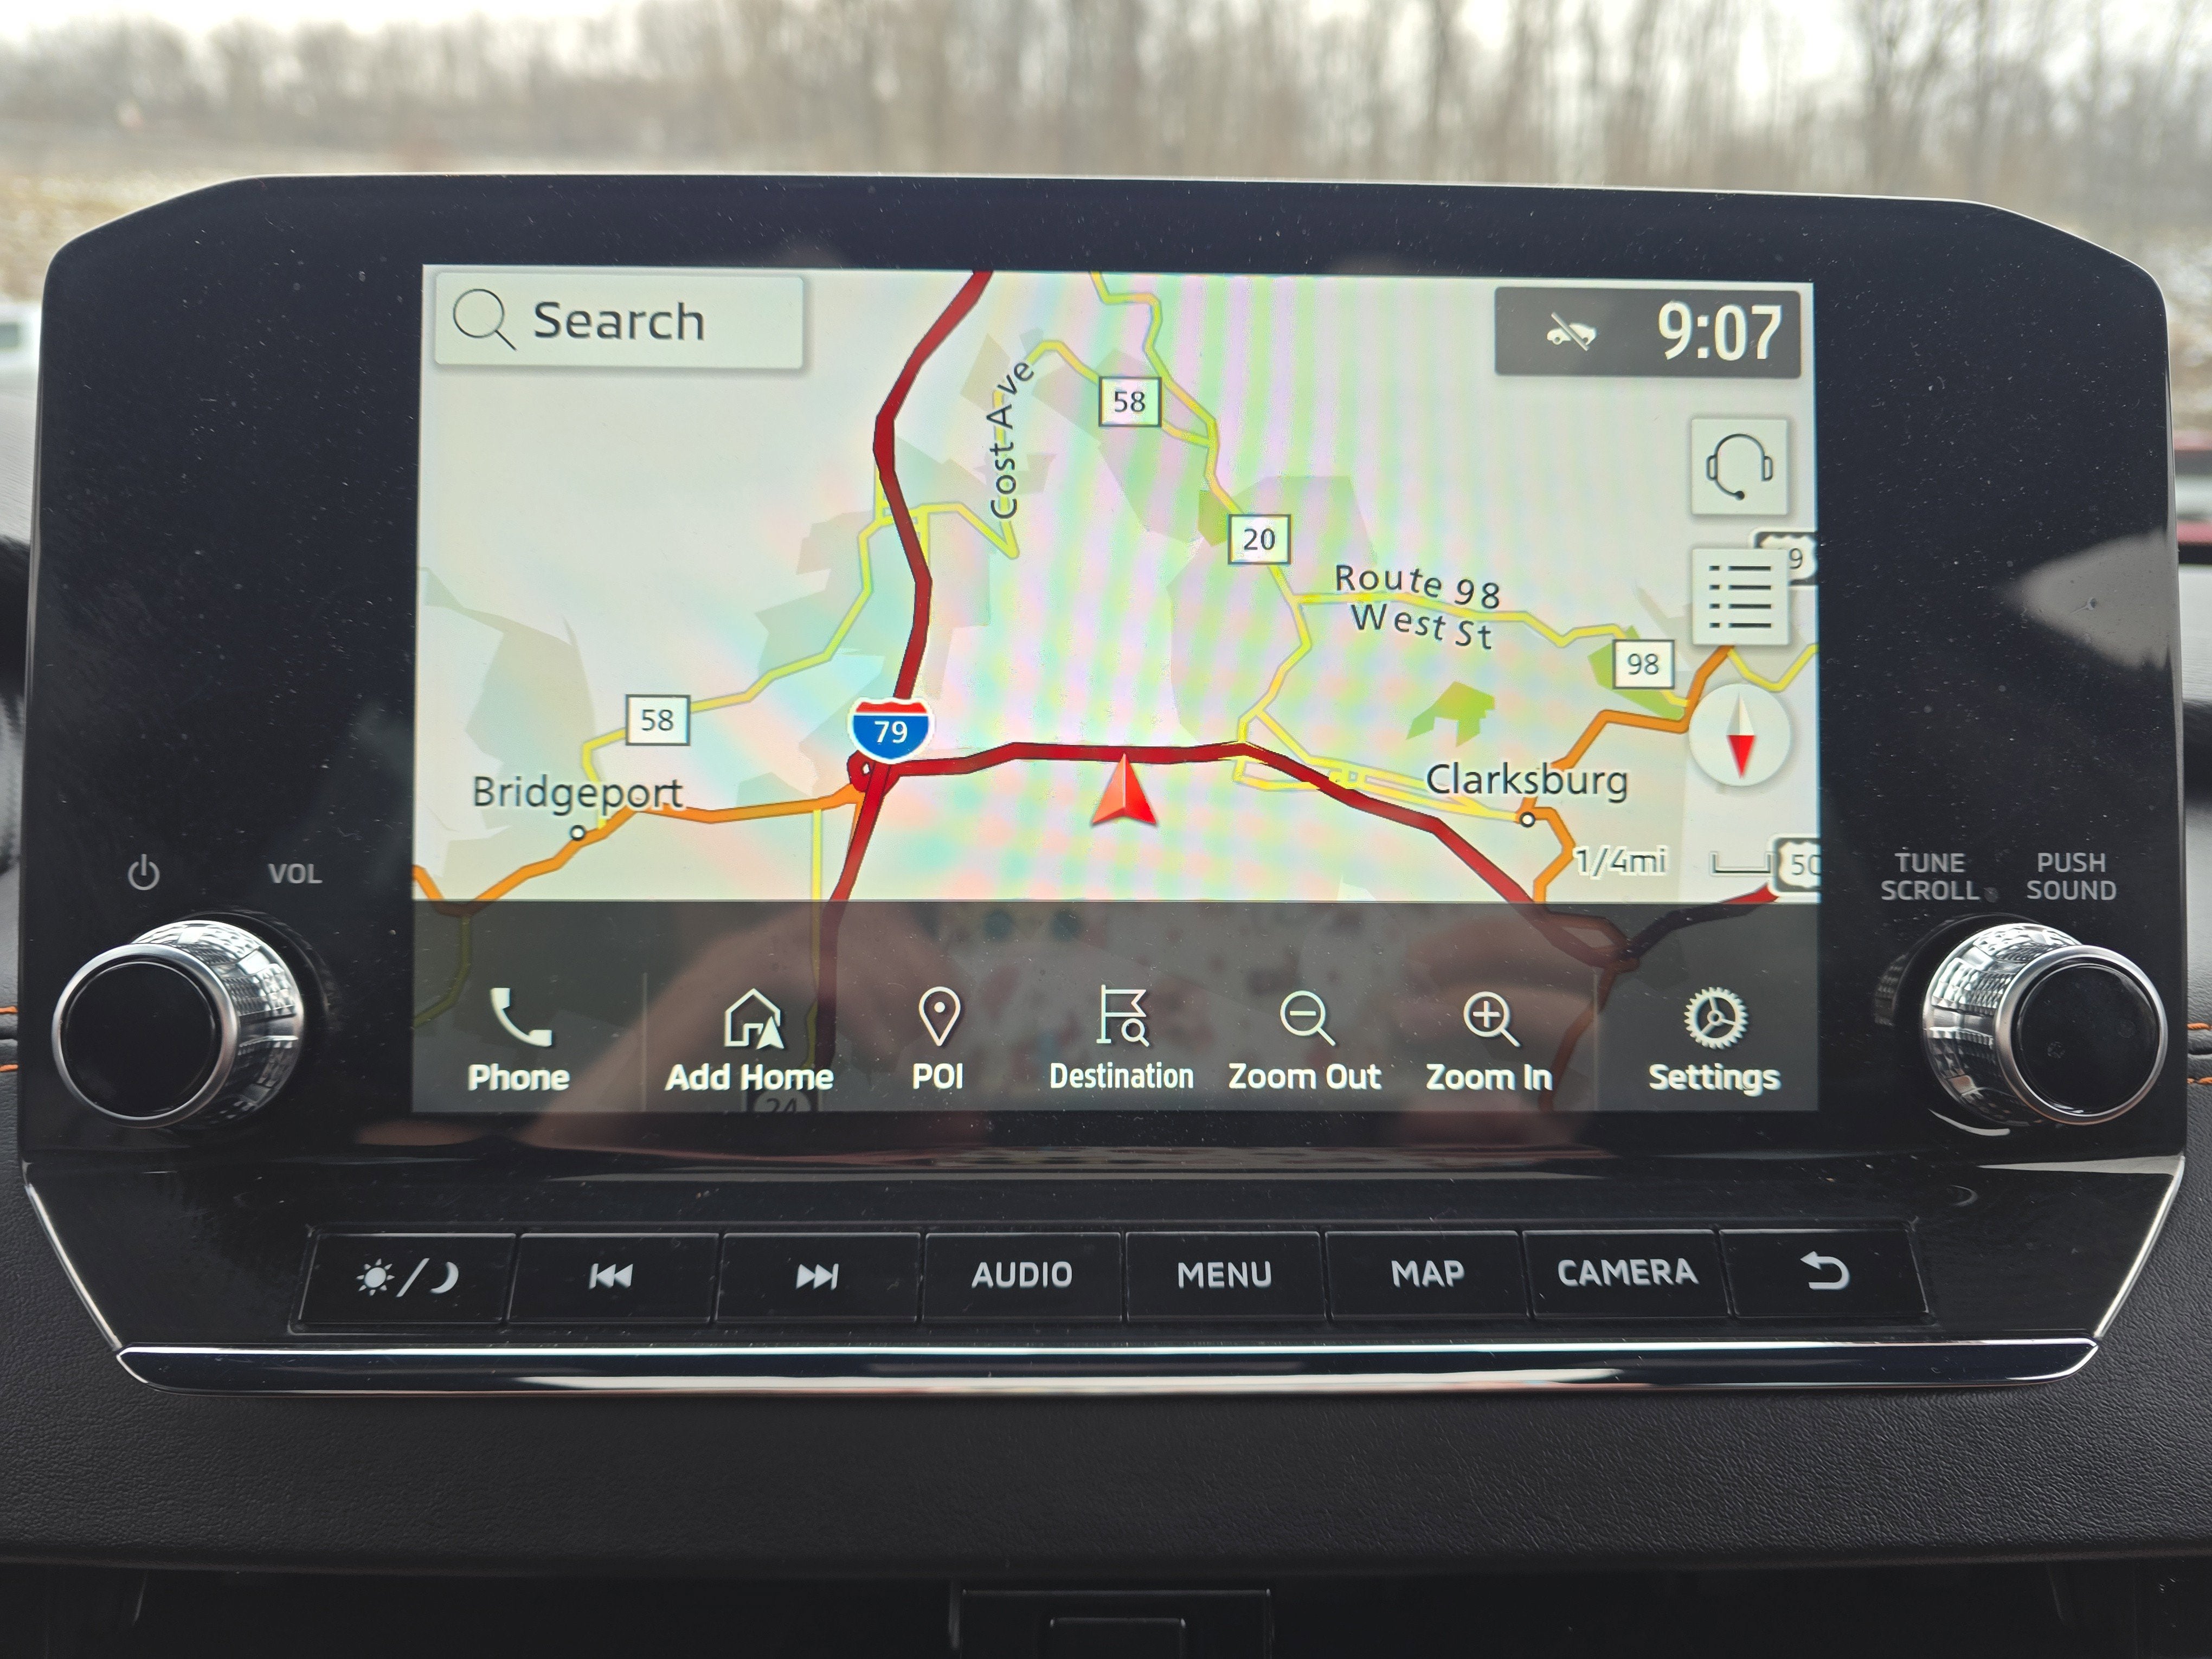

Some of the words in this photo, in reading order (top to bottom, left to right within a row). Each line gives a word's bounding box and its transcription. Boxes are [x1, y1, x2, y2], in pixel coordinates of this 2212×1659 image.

[533, 301, 704, 341] Search
[1658, 301, 1783, 361] 9:07
[986, 361, 1034, 429] Ave
[1113, 391, 1146, 413] 58
[990, 441, 1018, 519] Cost
[1243, 528, 1275, 550] 20
[1789, 548, 1803, 570] 9
[1335, 564, 1442, 597] Route
[1454, 579, 1500, 609] 98
[1351, 603, 1445, 641] West
[1455, 620, 1491, 650] St
[1626, 653, 1660, 675] 98
[640, 709, 674, 731] 58
[873, 721, 908, 744] 79
[473, 775, 684, 816] Bridgeport
[1426, 762, 1628, 803] Clarksburg
[268, 864, 323, 884] VOL
[1576, 847, 1667, 878] 1/4mi
[1791, 854, 1822, 876] 50
[1894, 853, 1966, 873] TUNE
[2037, 852, 2106, 873] PUSH
[1881, 880, 1981, 901] SCROLL
[2027, 880, 2117, 901] SOUND
[467, 1064, 570, 1091] Phone
[665, 1063, 730, 1091] Add
[741, 1064, 834, 1091] Home
[912, 1063, 963, 1089] POI
[1050, 1063, 1194, 1089] Destination
[1228, 1063, 1317, 1090] Zoom
[1326, 1063, 1381, 1090] Out
[1426, 1064, 1516, 1090] Zoom
[1524, 1064, 1553, 1091] In
[1649, 1063, 1782, 1096] Settings
[971, 1261, 1073, 1288] AUDIO
[1178, 1261, 1272, 1288] MENU
[1391, 1259, 1465, 1288] MAP
[1558, 1258, 1699, 1287] CAMERA
